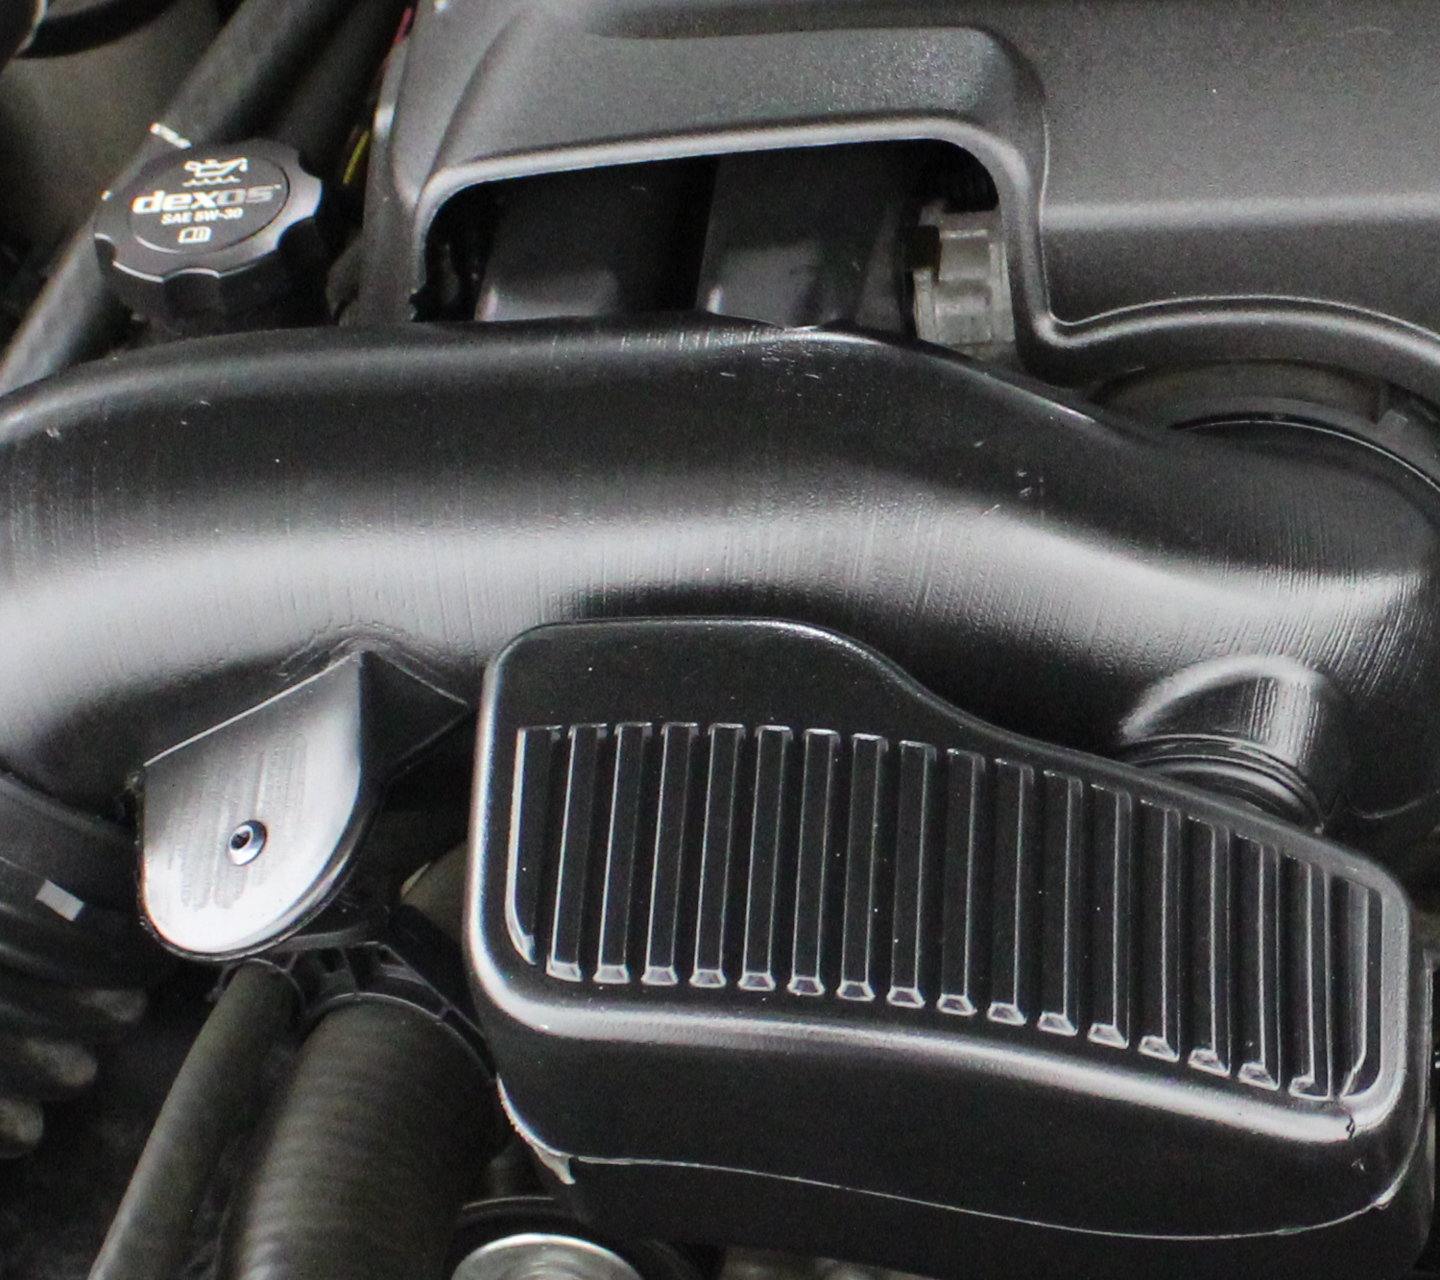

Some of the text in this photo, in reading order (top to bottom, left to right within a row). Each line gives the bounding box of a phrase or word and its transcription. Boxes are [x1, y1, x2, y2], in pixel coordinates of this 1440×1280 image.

[131, 186, 275, 214] dexos
[161, 207, 245, 225] SAE 5W-30
